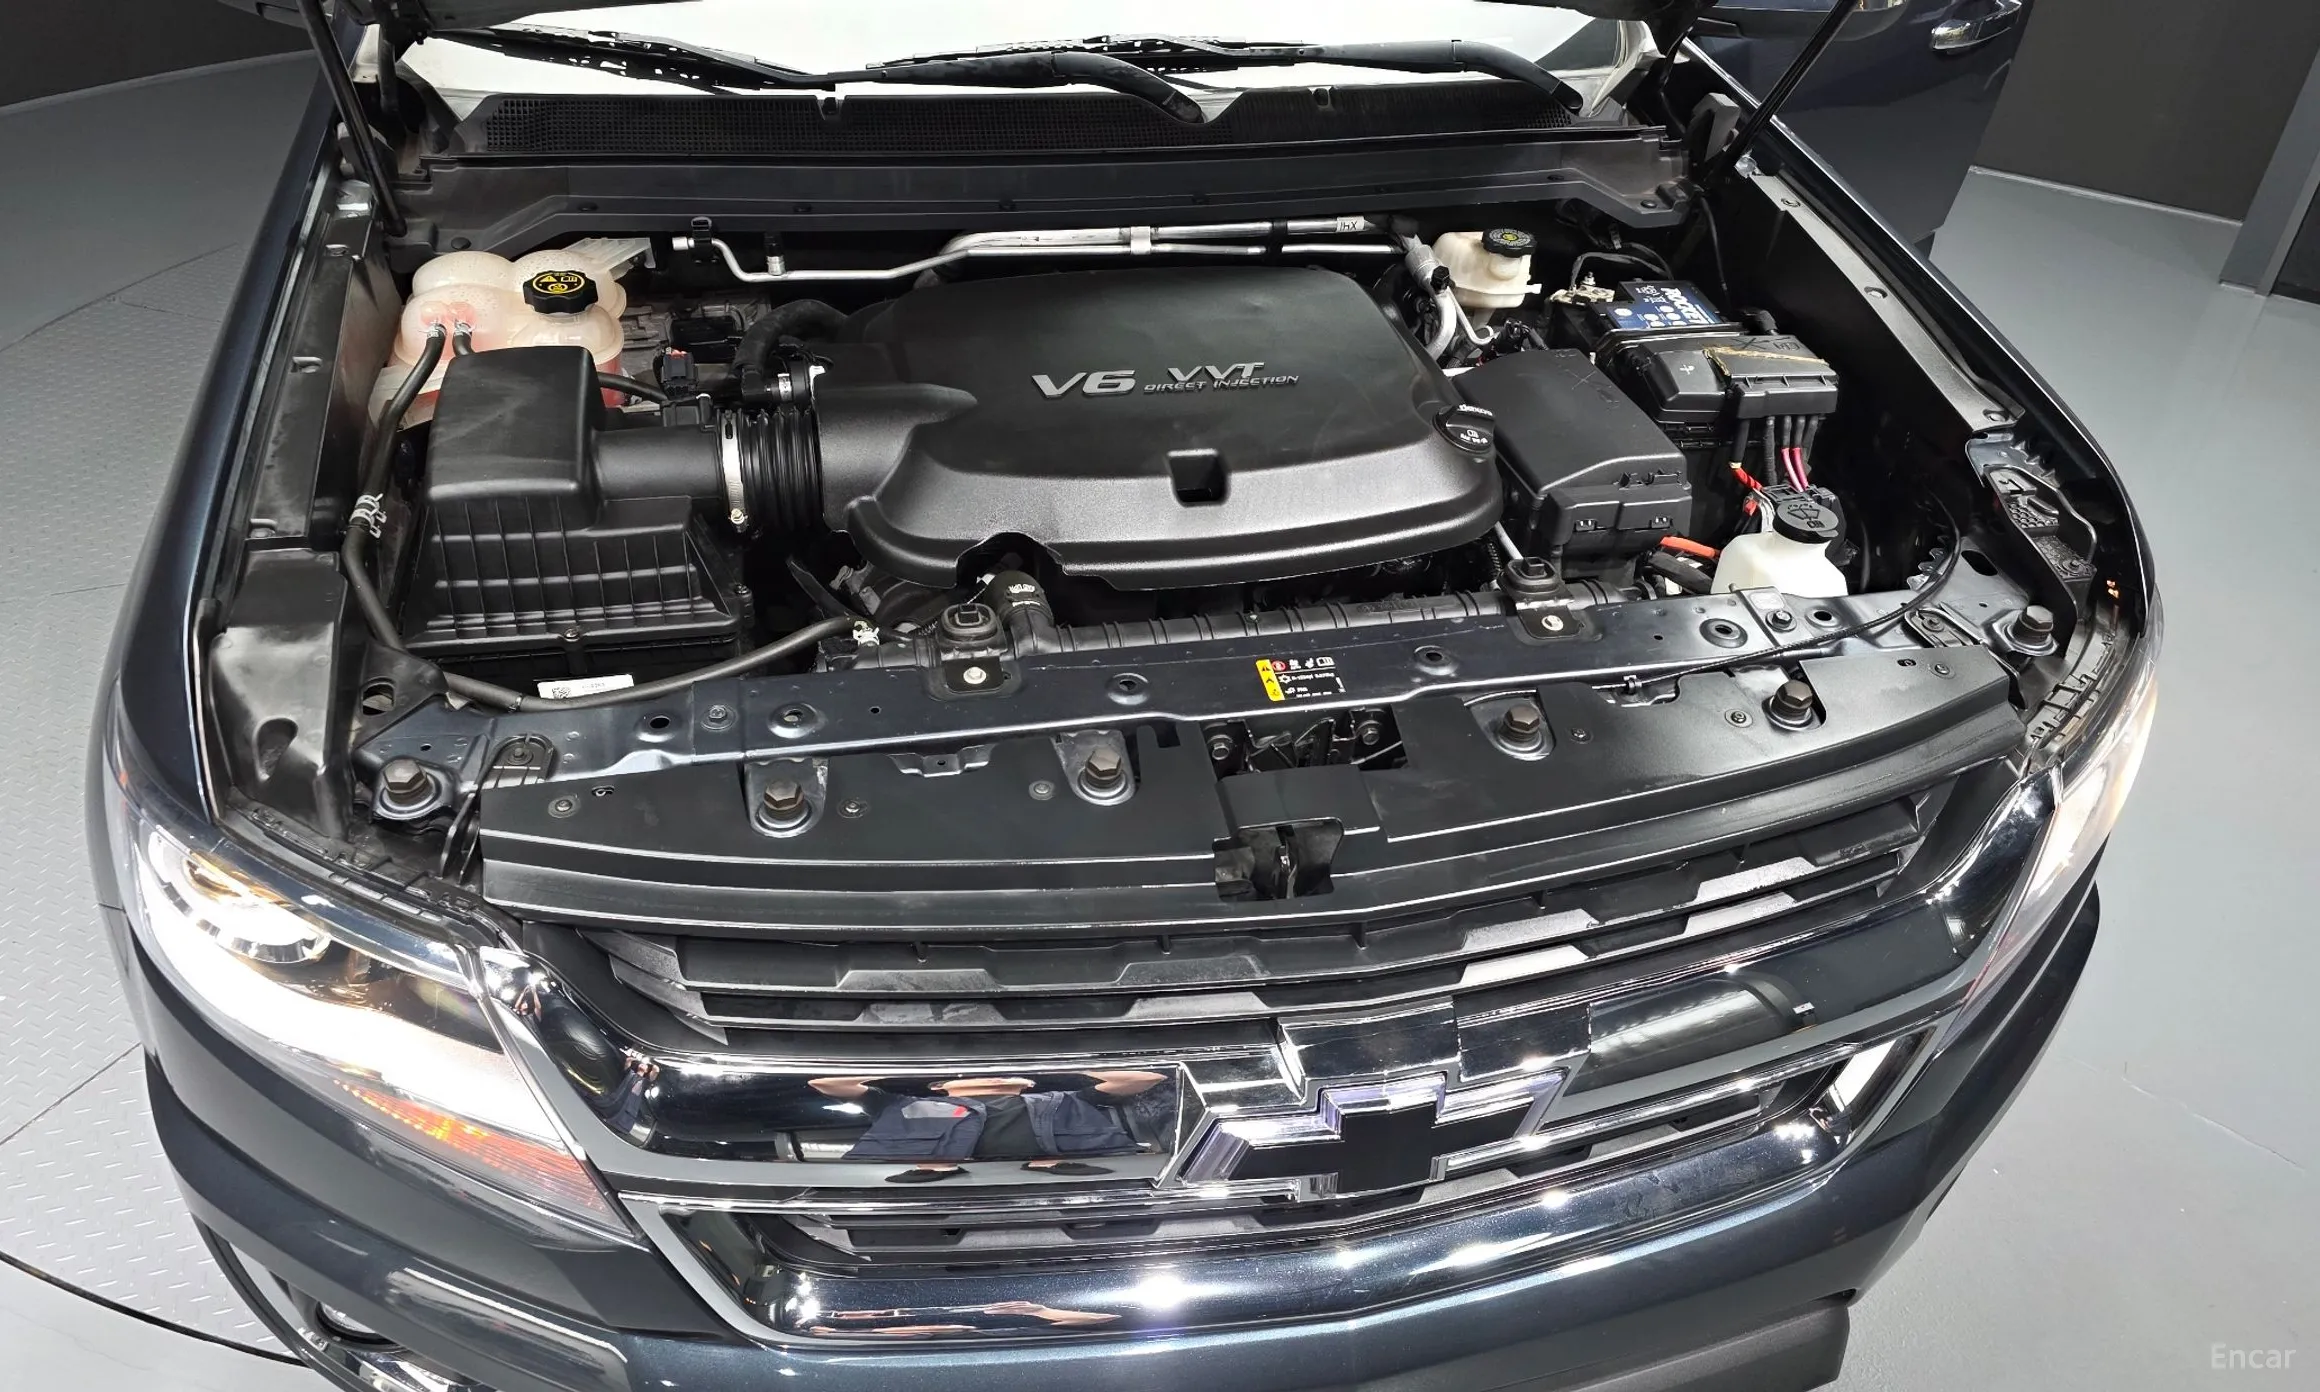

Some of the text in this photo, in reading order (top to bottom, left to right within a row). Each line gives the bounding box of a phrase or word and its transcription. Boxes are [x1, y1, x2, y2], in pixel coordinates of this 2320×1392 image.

[1660, 287, 1709, 324] ROCKET
[1032, 369, 1137, 398] V6
[1143, 374, 1299, 394] DIRECT INJECTION
[1167, 362, 1265, 383] VVT
